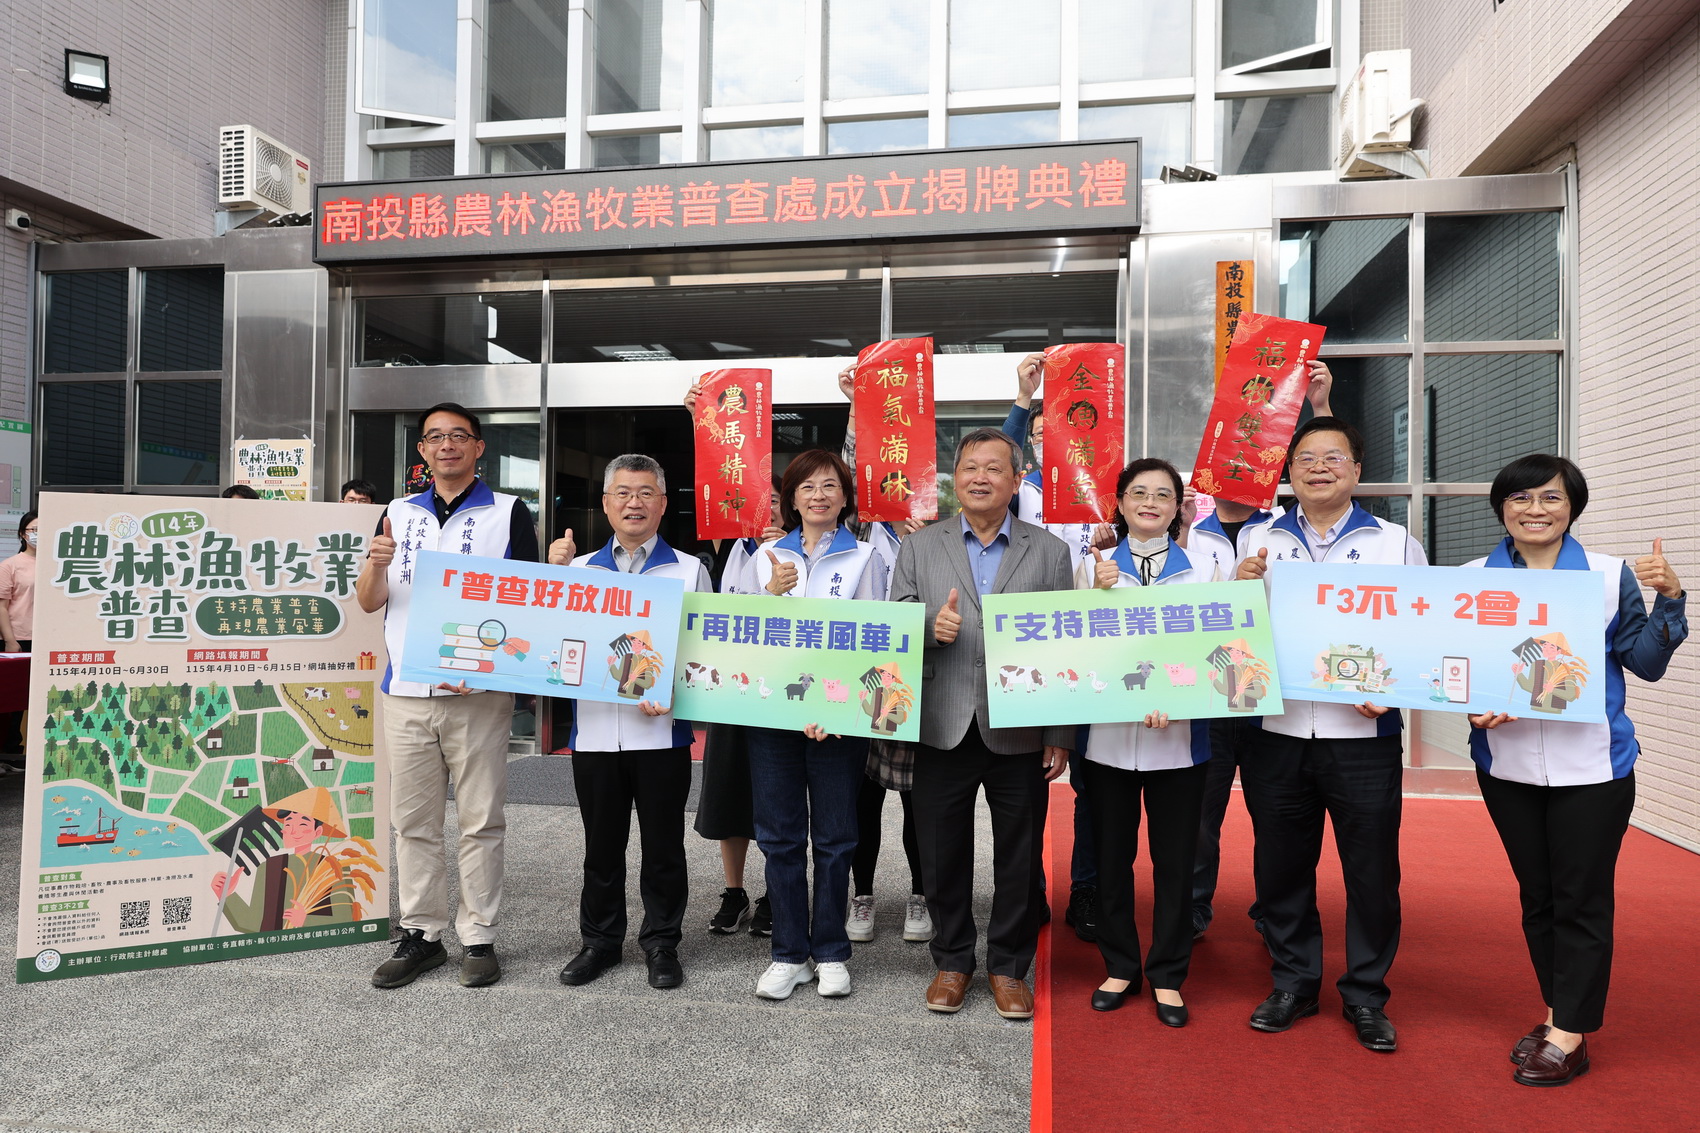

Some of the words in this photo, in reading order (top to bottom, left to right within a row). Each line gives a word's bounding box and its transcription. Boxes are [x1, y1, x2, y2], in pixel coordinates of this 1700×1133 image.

[323, 157, 1128, 243] 南投縣農林漁牧業普查處成立揭牌典禮
[1225, 262, 1245, 354] 南投縣農
[1220, 336, 1287, 481] 福牧雙全
[876, 358, 915, 502] 福氣滿林
[1066, 362, 1100, 506] 金漁滿堂
[239, 447, 304, 466] 農林漁牧業
[718, 384, 749, 523] 農馬精神
[149, 513, 201, 534] 114年
[460, 517, 476, 555] 南投縣
[55, 525, 365, 597] 農林漁牧業
[442, 568, 652, 618] 「普查好放心」
[829, 573, 843, 599] 南投
[99, 589, 192, 640] 普查
[214, 597, 320, 616] 支持農業普查
[994, 602, 1255, 642] 「支持農業普查」
[217, 617, 325, 635] 再現農業風華
[686, 612, 909, 653] 「再現農業風華」
[49, 665, 169, 676] 115年4月10日~6月30日
[57, 652, 105, 664] 普查期間
[193, 649, 261, 661] 網路填報期間
[44, 873, 77, 882] 普查對象
[42, 901, 85, 912] 普查3不2會
[68, 948, 168, 966] 主辦單位：行政院主計總處
